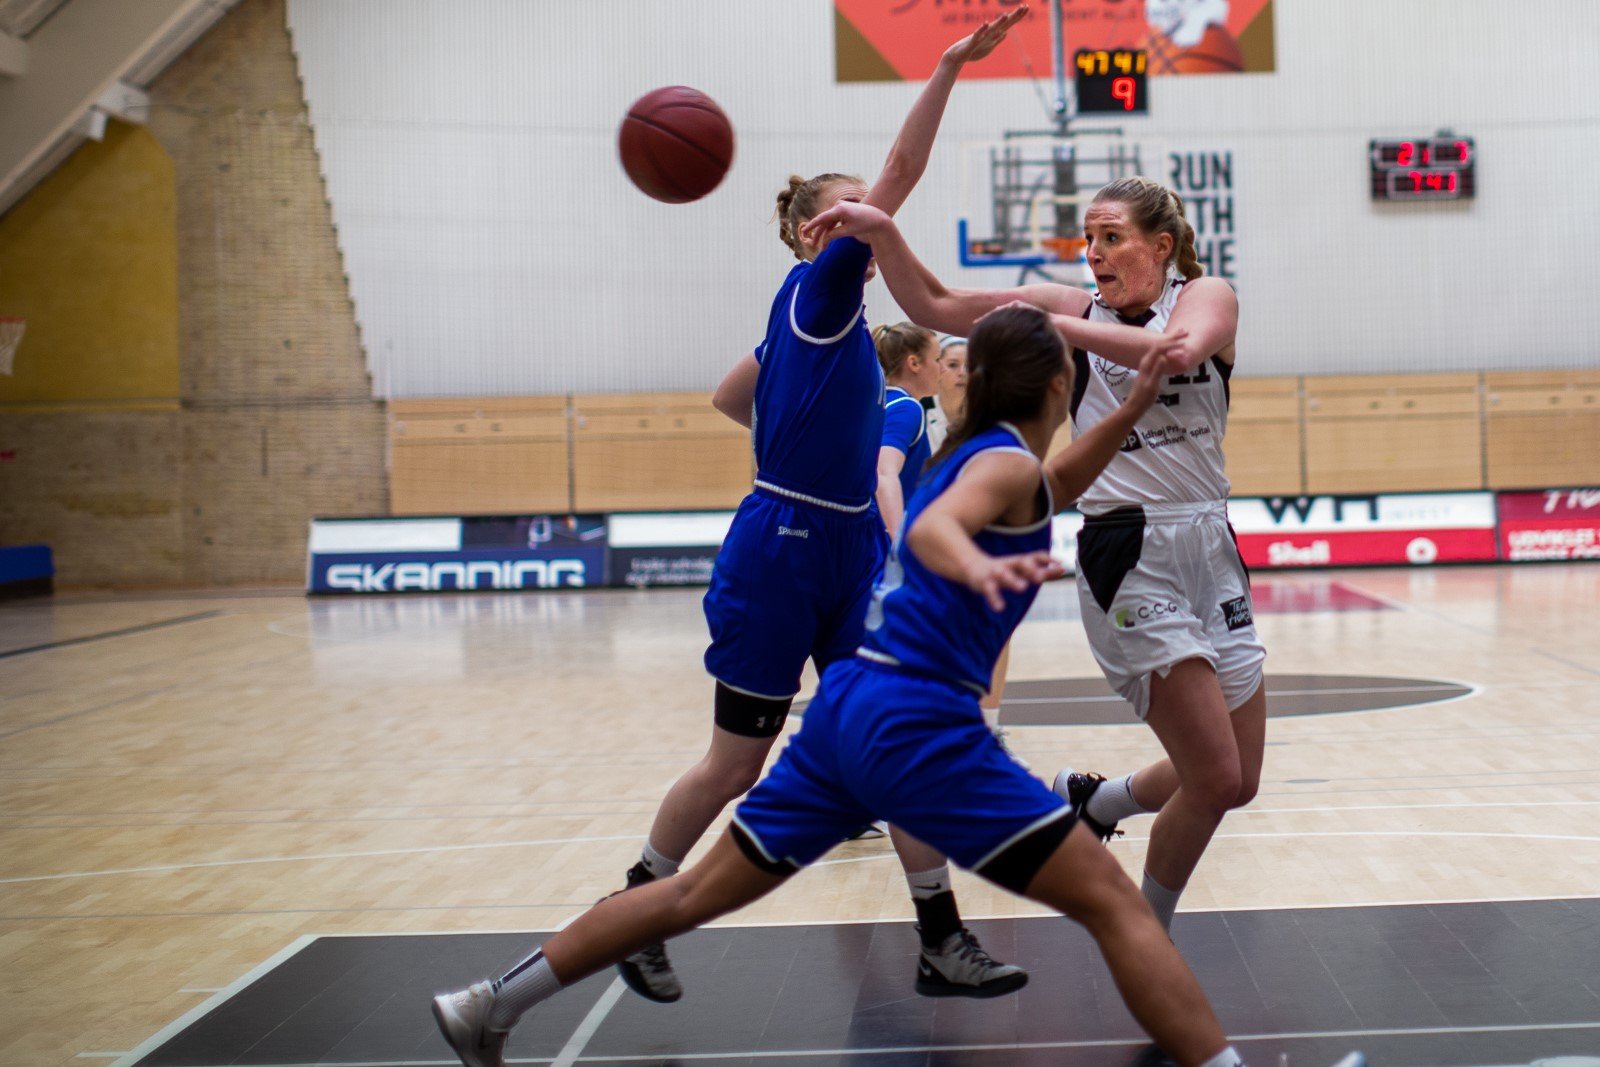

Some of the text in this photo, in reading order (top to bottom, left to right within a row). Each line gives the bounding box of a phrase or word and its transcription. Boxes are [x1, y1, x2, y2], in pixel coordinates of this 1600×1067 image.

[1112, 77, 1136, 111] 9
[1168, 152, 1233, 191] RUN
[1398, 141, 1415, 166] 2
[1182, 197, 1234, 234] TH
[1195, 239, 1236, 279] HE
